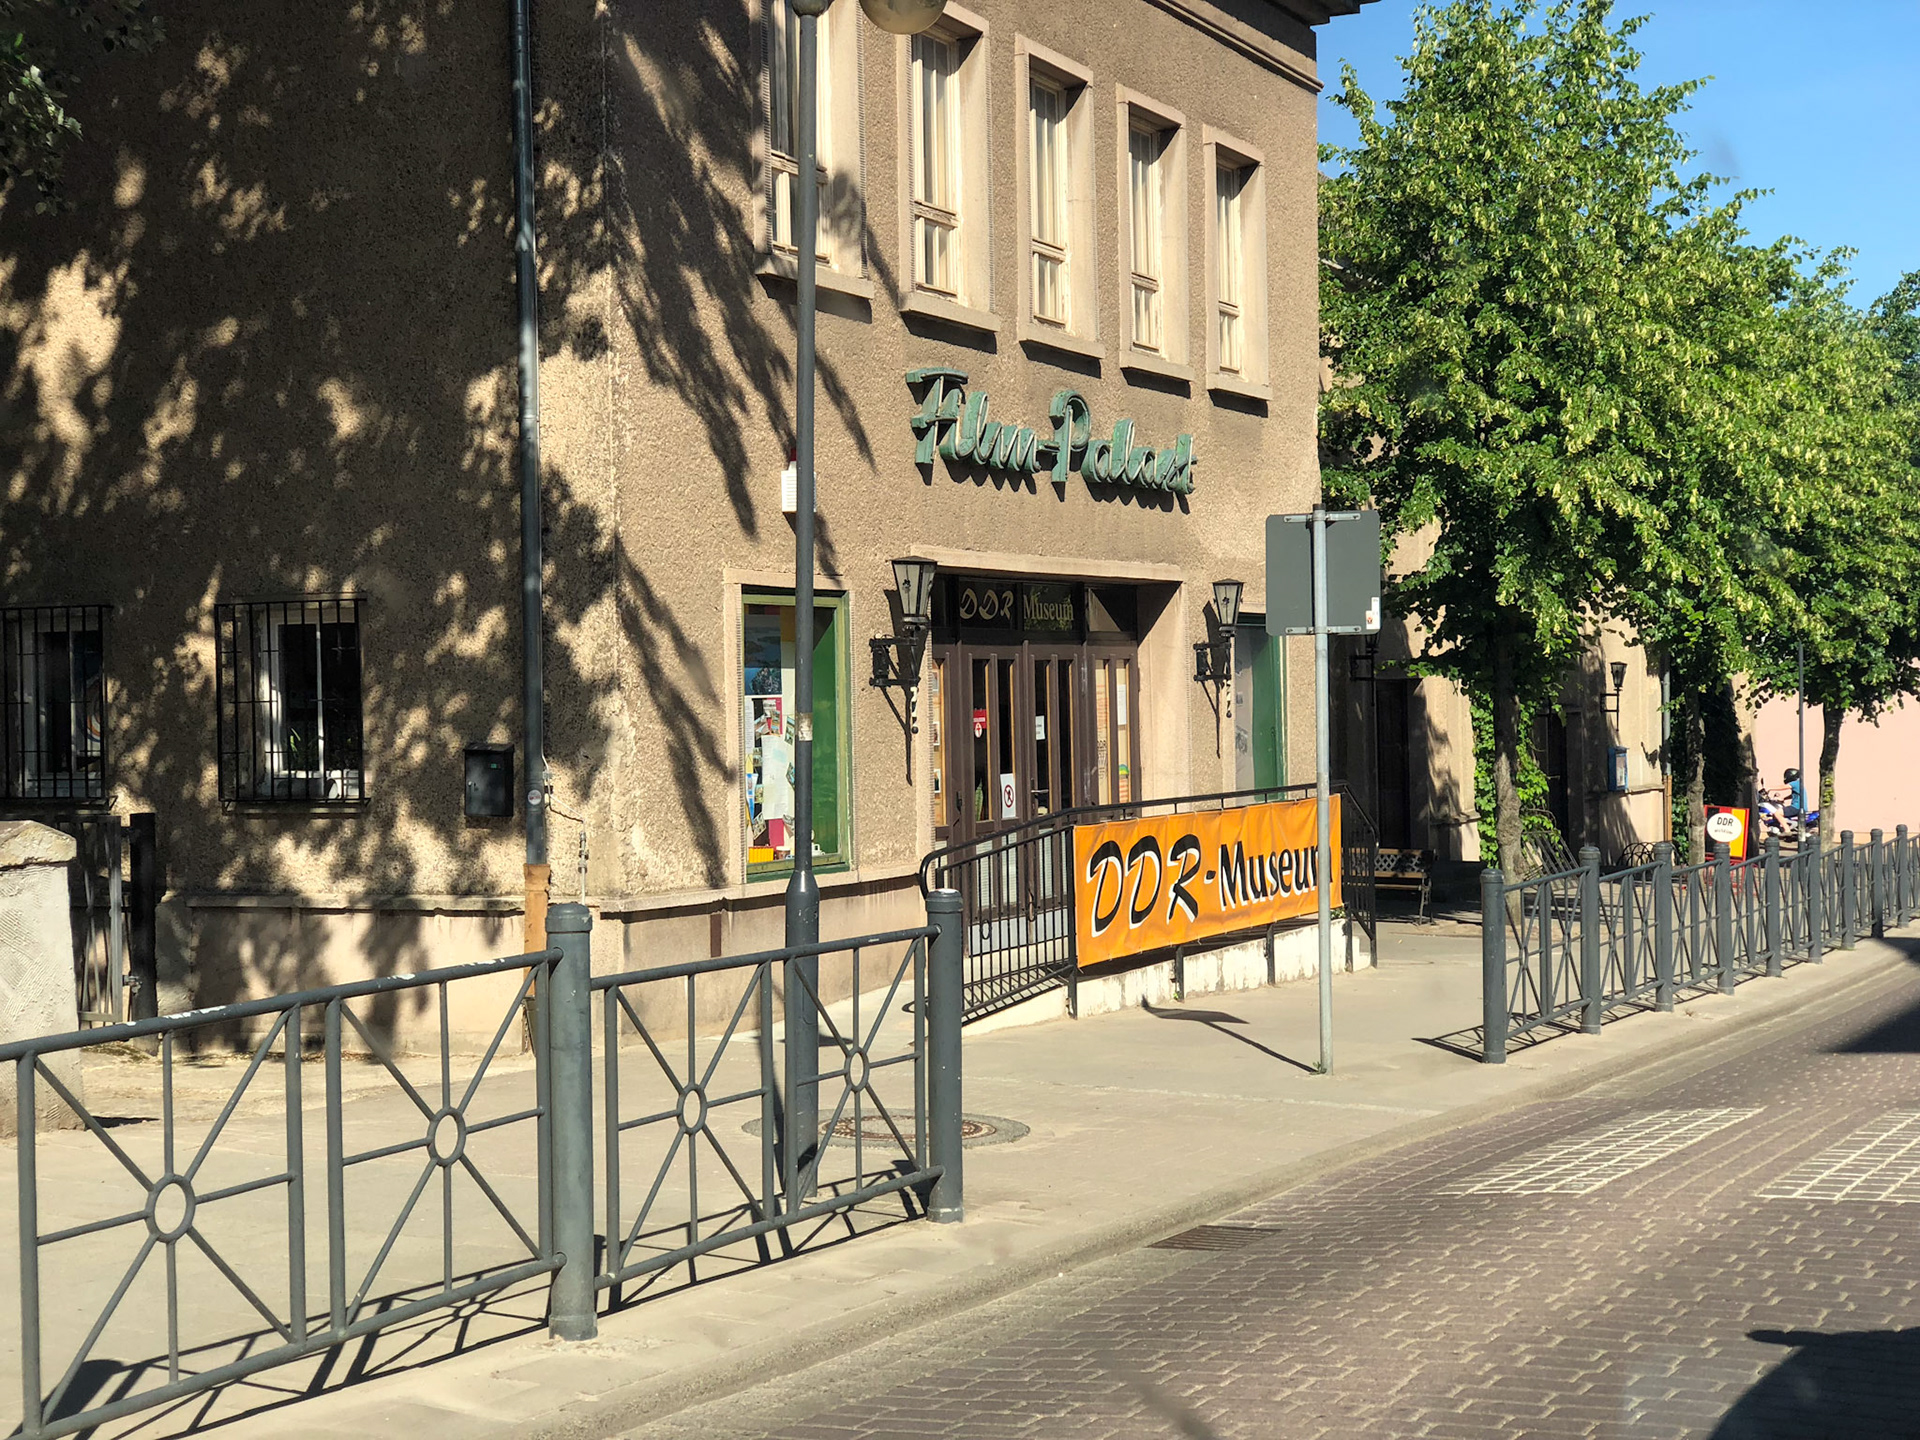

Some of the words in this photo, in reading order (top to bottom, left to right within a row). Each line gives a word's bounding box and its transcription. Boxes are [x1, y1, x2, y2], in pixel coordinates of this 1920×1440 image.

[906, 367, 1197, 494] Film-Palast
[959, 588, 1014, 620] DDR
[1023, 594, 1074, 621] Museum
[1716, 816, 1734, 827] DDR
